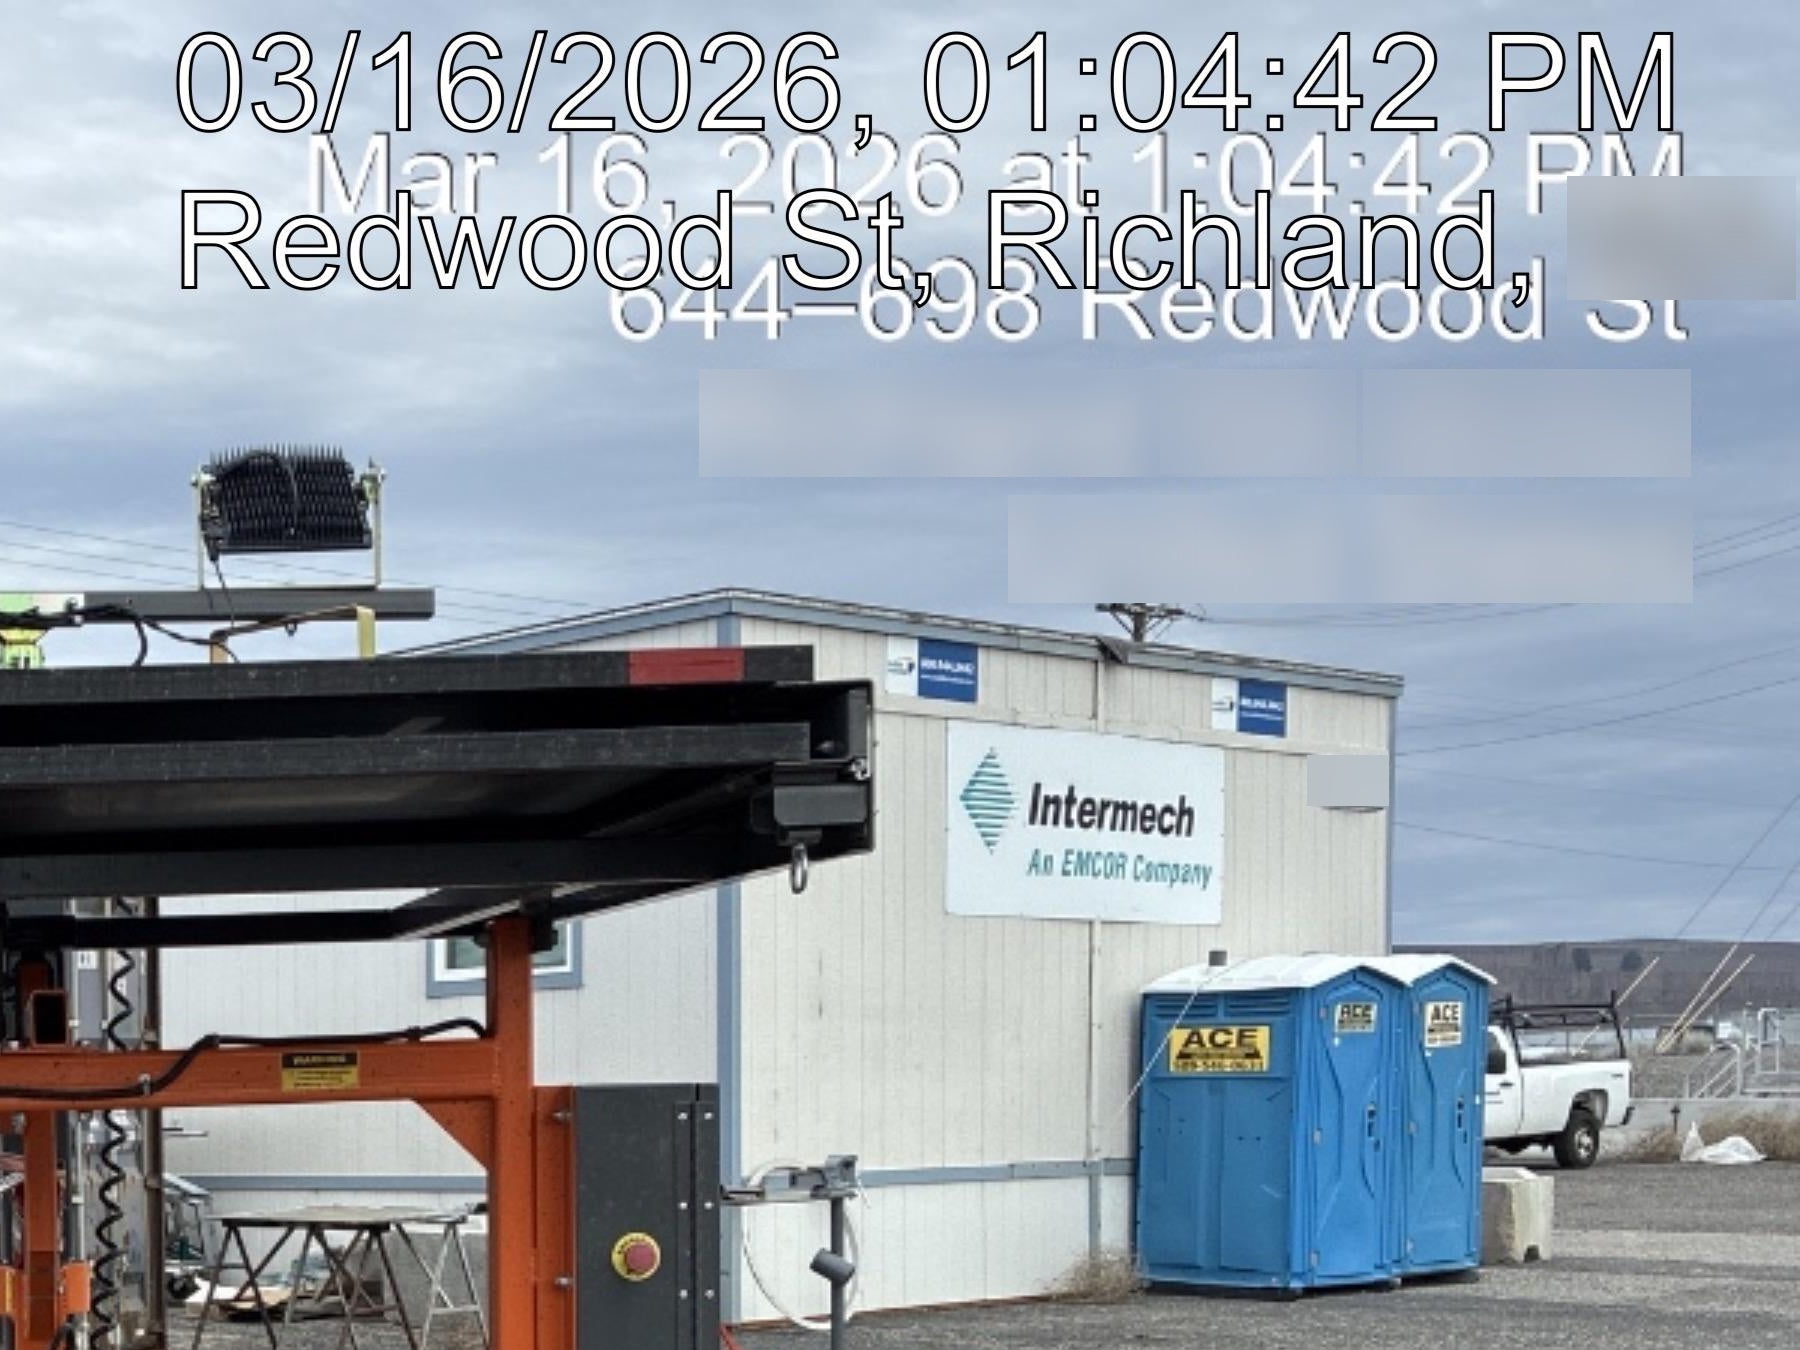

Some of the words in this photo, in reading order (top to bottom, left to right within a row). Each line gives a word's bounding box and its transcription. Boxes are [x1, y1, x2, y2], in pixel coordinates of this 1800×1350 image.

[1028, 781, 1195, 838] Intermech
[1026, 848, 1055, 878] An
[1061, 848, 1129, 881] EMCOR
[1133, 854, 1213, 891] Company
[1340, 1003, 1373, 1019] ACE
[1431, 1003, 1460, 1021] ACE
[1182, 1028, 1259, 1049] ACE
